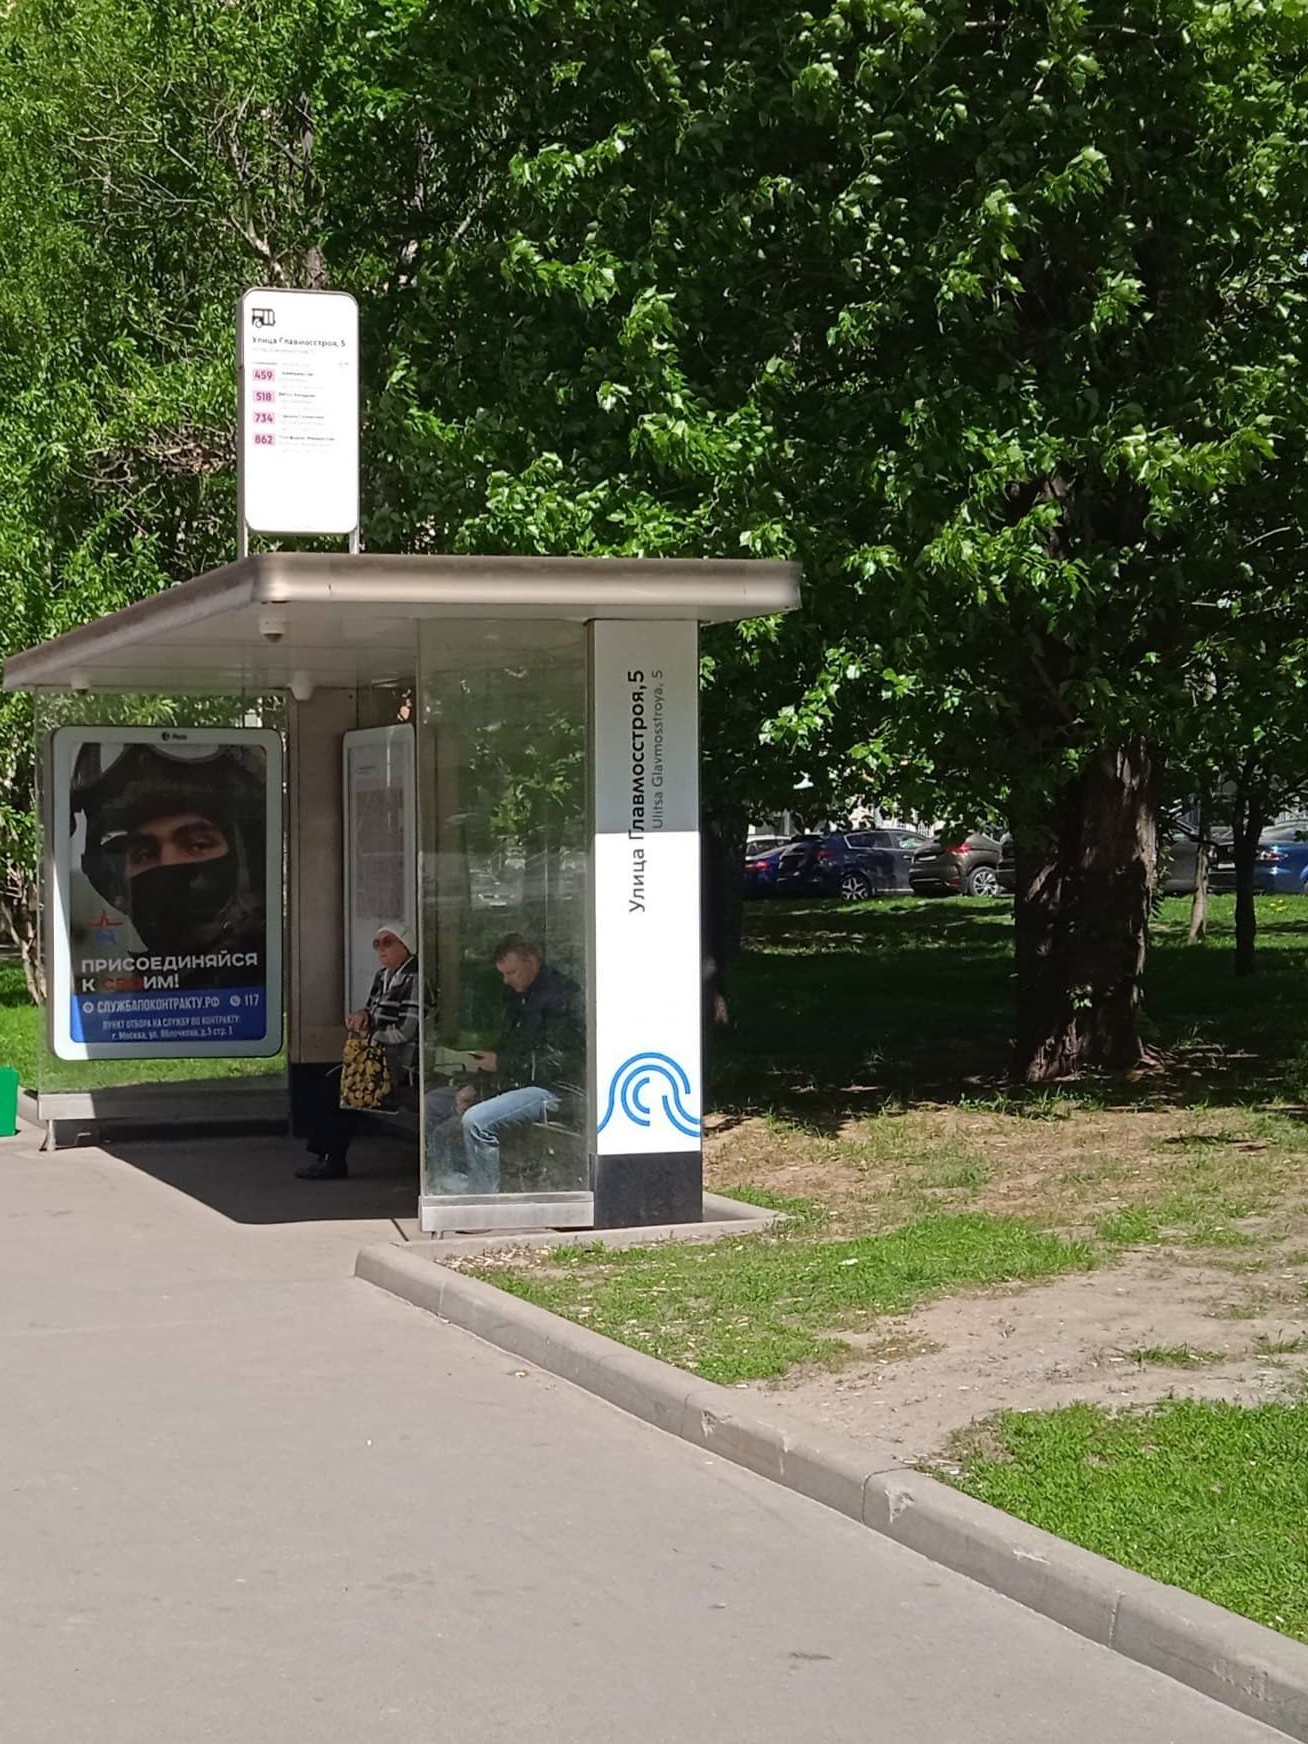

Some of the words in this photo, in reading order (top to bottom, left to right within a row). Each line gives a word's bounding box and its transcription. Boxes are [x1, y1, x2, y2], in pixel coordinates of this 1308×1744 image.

[254, 370, 273, 380] 459
[256, 392, 272, 402] 518
[255, 413, 273, 423] 734
[255, 435, 273, 445] 862
[652, 669, 663, 678] 5
[652, 683, 665, 787] Glavmosstroya,
[652, 791, 663, 829] Ulitsa
[628, 848, 647, 912] Улица
[81, 950, 258, 973] ПРИСОЕДИНЯЙСЯ
[82, 978, 95, 992] К
[97, 996, 220, 1013] СЛУЖБАПОКОНТРАКТУ.РФ
[244, 993, 259, 1006] 117
